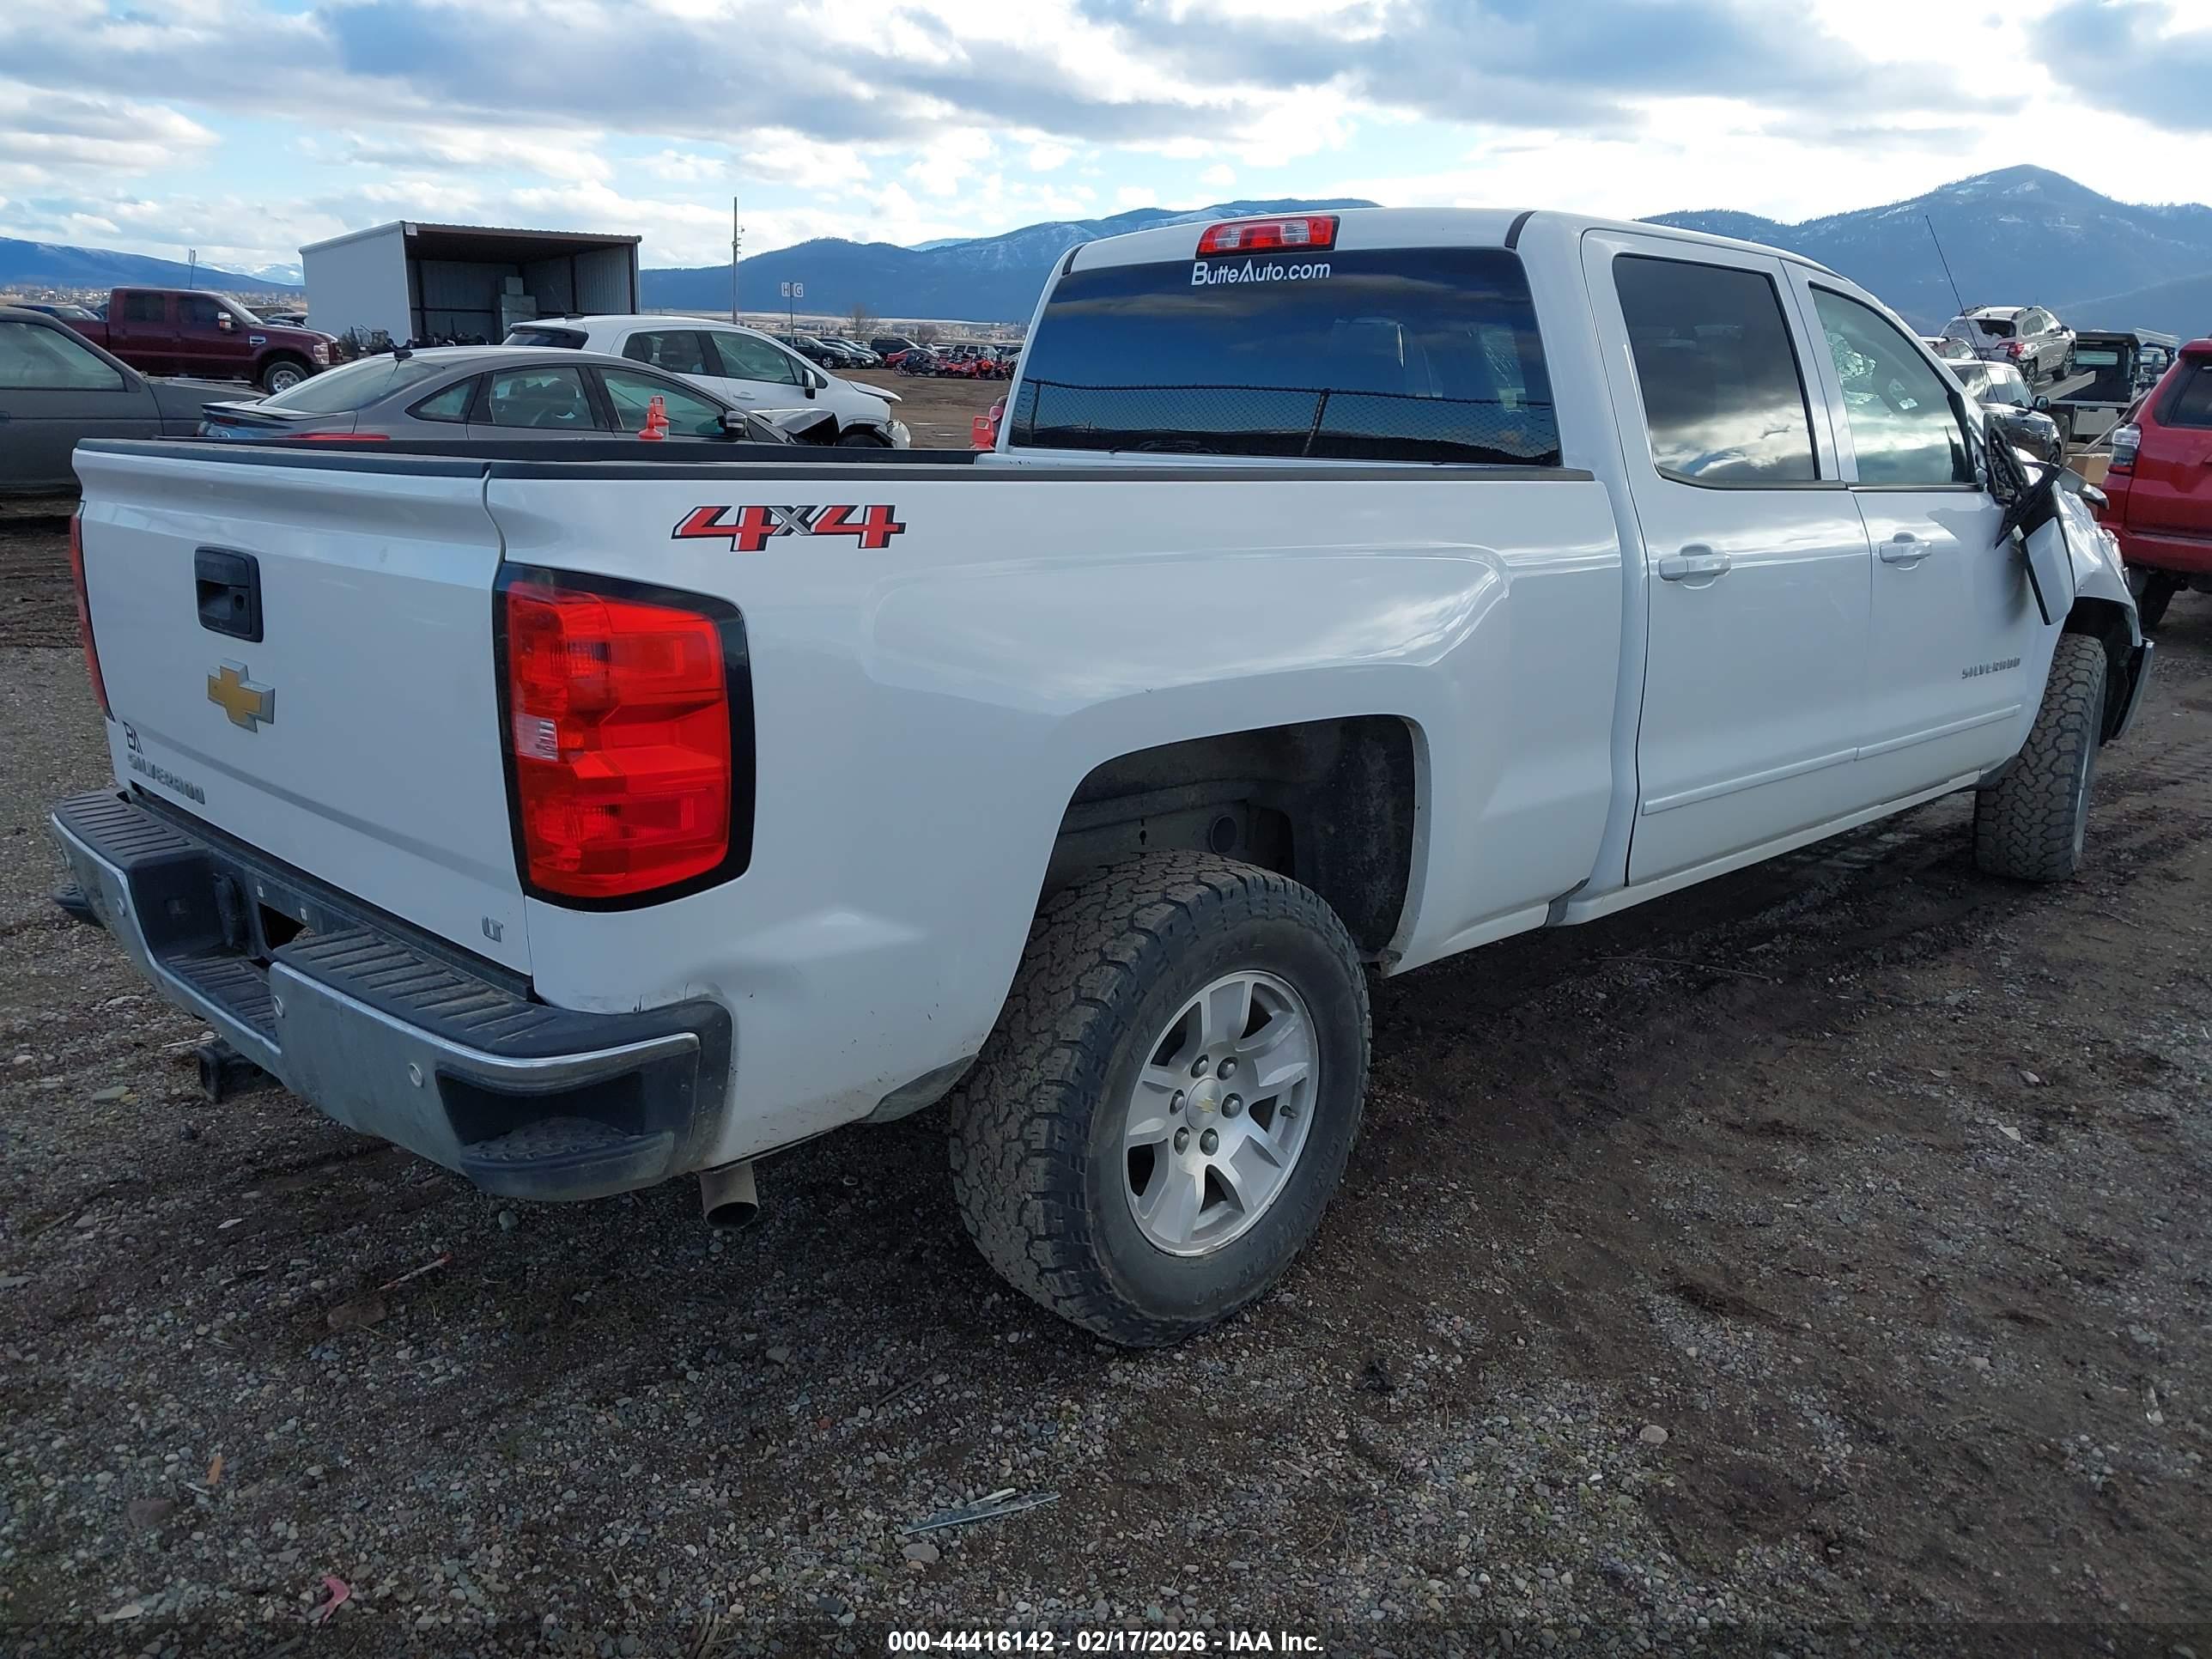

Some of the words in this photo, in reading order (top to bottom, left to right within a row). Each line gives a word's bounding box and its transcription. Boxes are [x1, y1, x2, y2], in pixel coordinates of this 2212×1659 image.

[1191, 258, 1331, 286] ButteAuto.com
[795, 284, 802, 296] G
[128, 752, 205, 805] SILVERADO
[482, 915, 504, 943] LT
